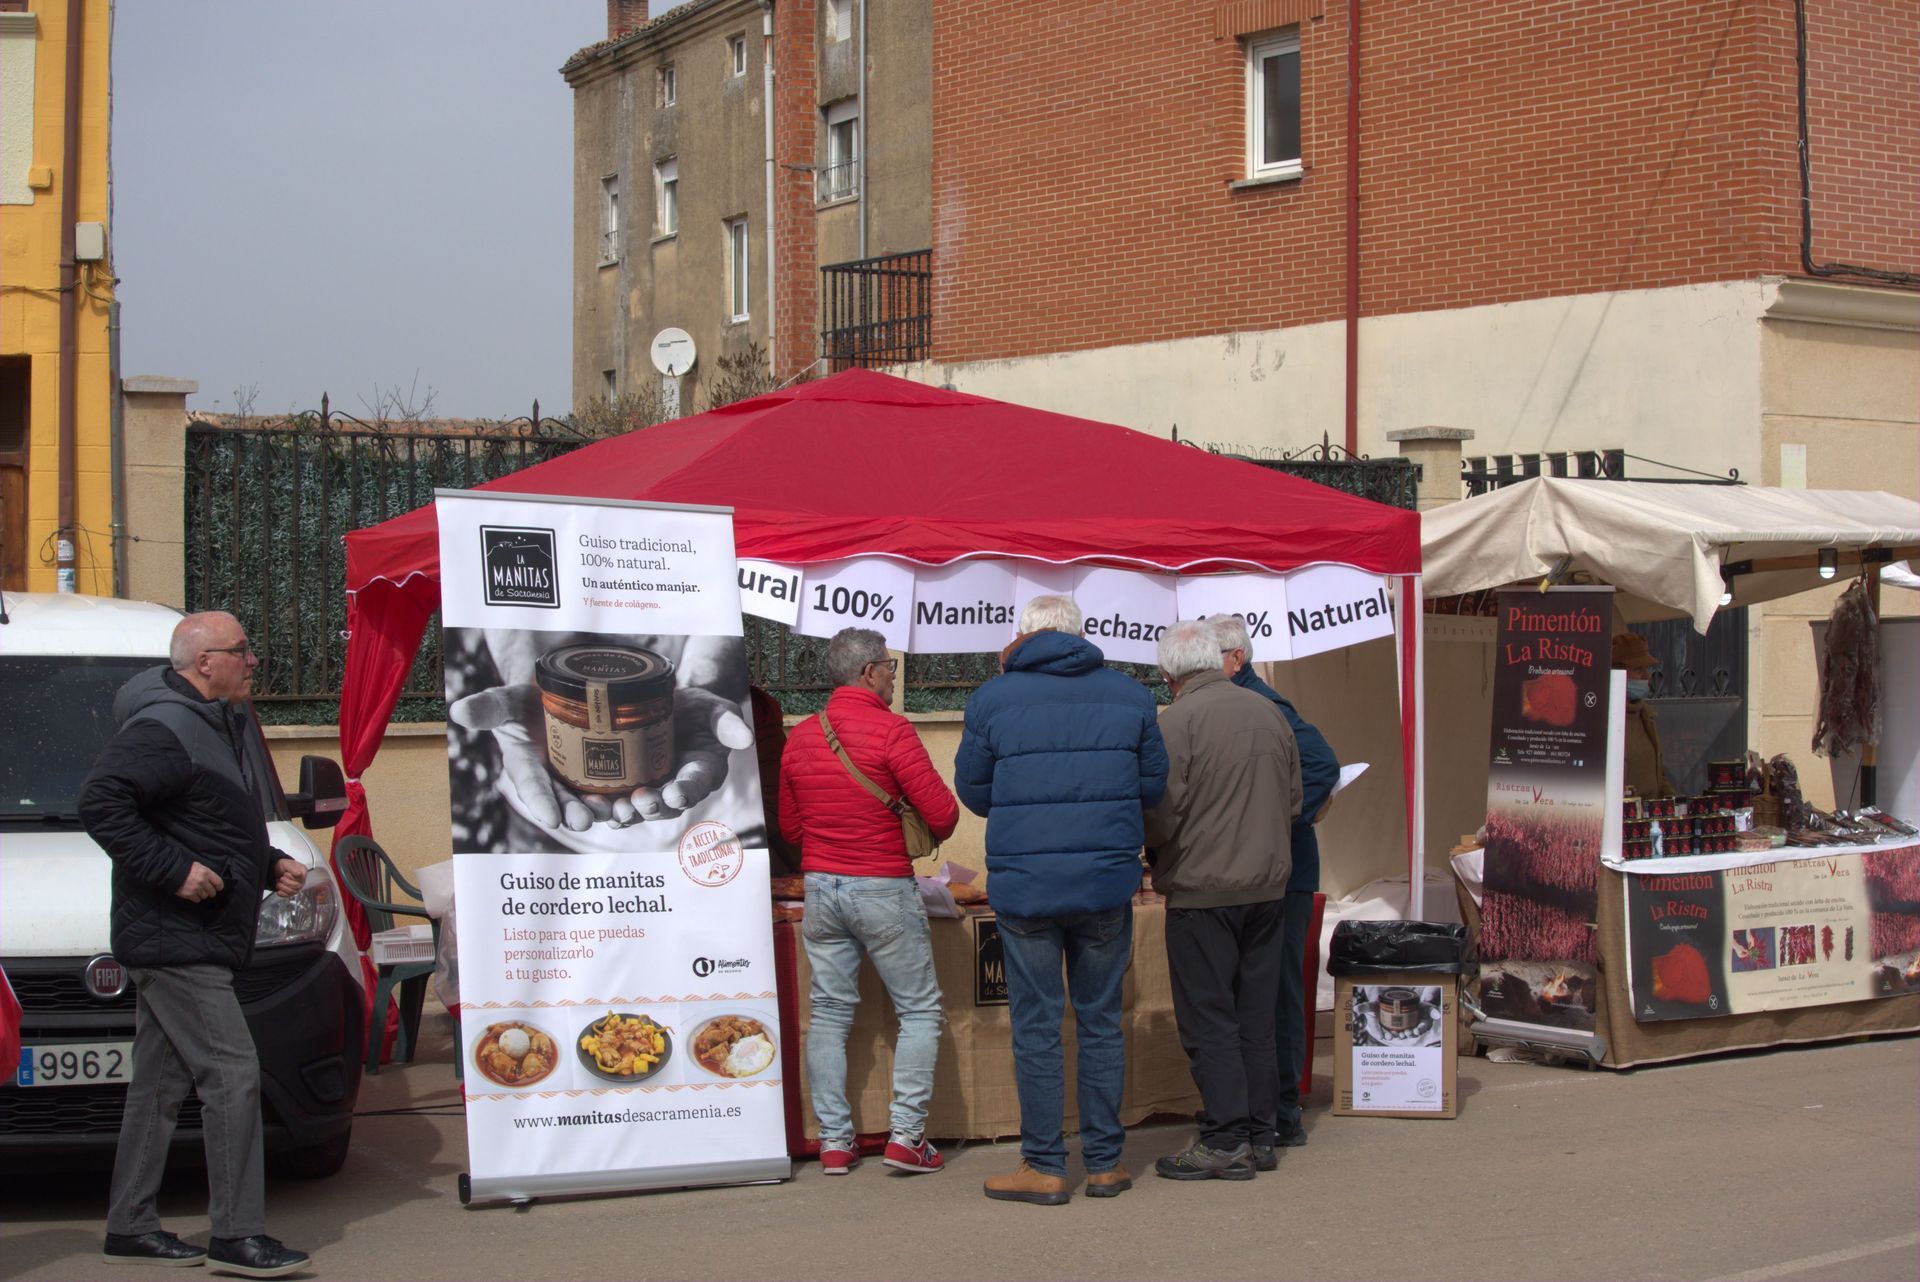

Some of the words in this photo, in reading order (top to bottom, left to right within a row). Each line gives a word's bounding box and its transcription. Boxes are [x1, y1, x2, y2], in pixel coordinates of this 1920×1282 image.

[579, 534, 617, 550] Guiso
[619, 537, 697, 555] tradicional,
[516, 554, 525, 565] LA
[581, 553, 614, 568] 100%
[617, 557, 670, 571] natural.
[493, 565, 549, 588] MANITAS
[582, 577, 598, 589] Un
[599, 579, 654, 591] auténtico
[656, 581, 701, 594] manjar.
[494, 588, 505, 597] de
[614, 599, 624, 608] de
[812, 583, 895, 623] 100%
[1287, 587, 1388, 637] Natural
[1506, 607, 1602, 633] Pimentón
[1505, 642, 1532, 665] La
[1538, 637, 1593, 667] Ristra
[588, 759, 620, 771] MANITAS
[1496, 782, 1530, 793] Ristras
[692, 829, 719, 848] RECETA
[687, 842, 736, 868] TRADICIONAL
[500, 872, 555, 890] Guiso
[558, 872, 581, 890] de
[585, 871, 665, 889] manitas
[1731, 883, 1745, 895] La
[1746, 878, 1773, 892] Ristra
[502, 897, 525, 915] de
[529, 897, 604, 915] cordero
[607, 895, 673, 914] lechal.
[1667, 900, 1708, 919] Ristra
[503, 927, 537, 941] Listo
[538, 930, 567, 945] para
[569, 929, 596, 943] que
[598, 925, 645, 942] puedas
[504, 945, 594, 964] personalizarlo
[95, 967, 120, 988] FIAT
[505, 970, 513, 980] a
[516, 969, 530, 980] tu
[532, 968, 572, 983] gusto.
[984, 960, 1008, 984] MA
[40, 1049, 123, 1081] 9962
[513, 1104, 742, 1129] www.manitasdesacramenia.es
